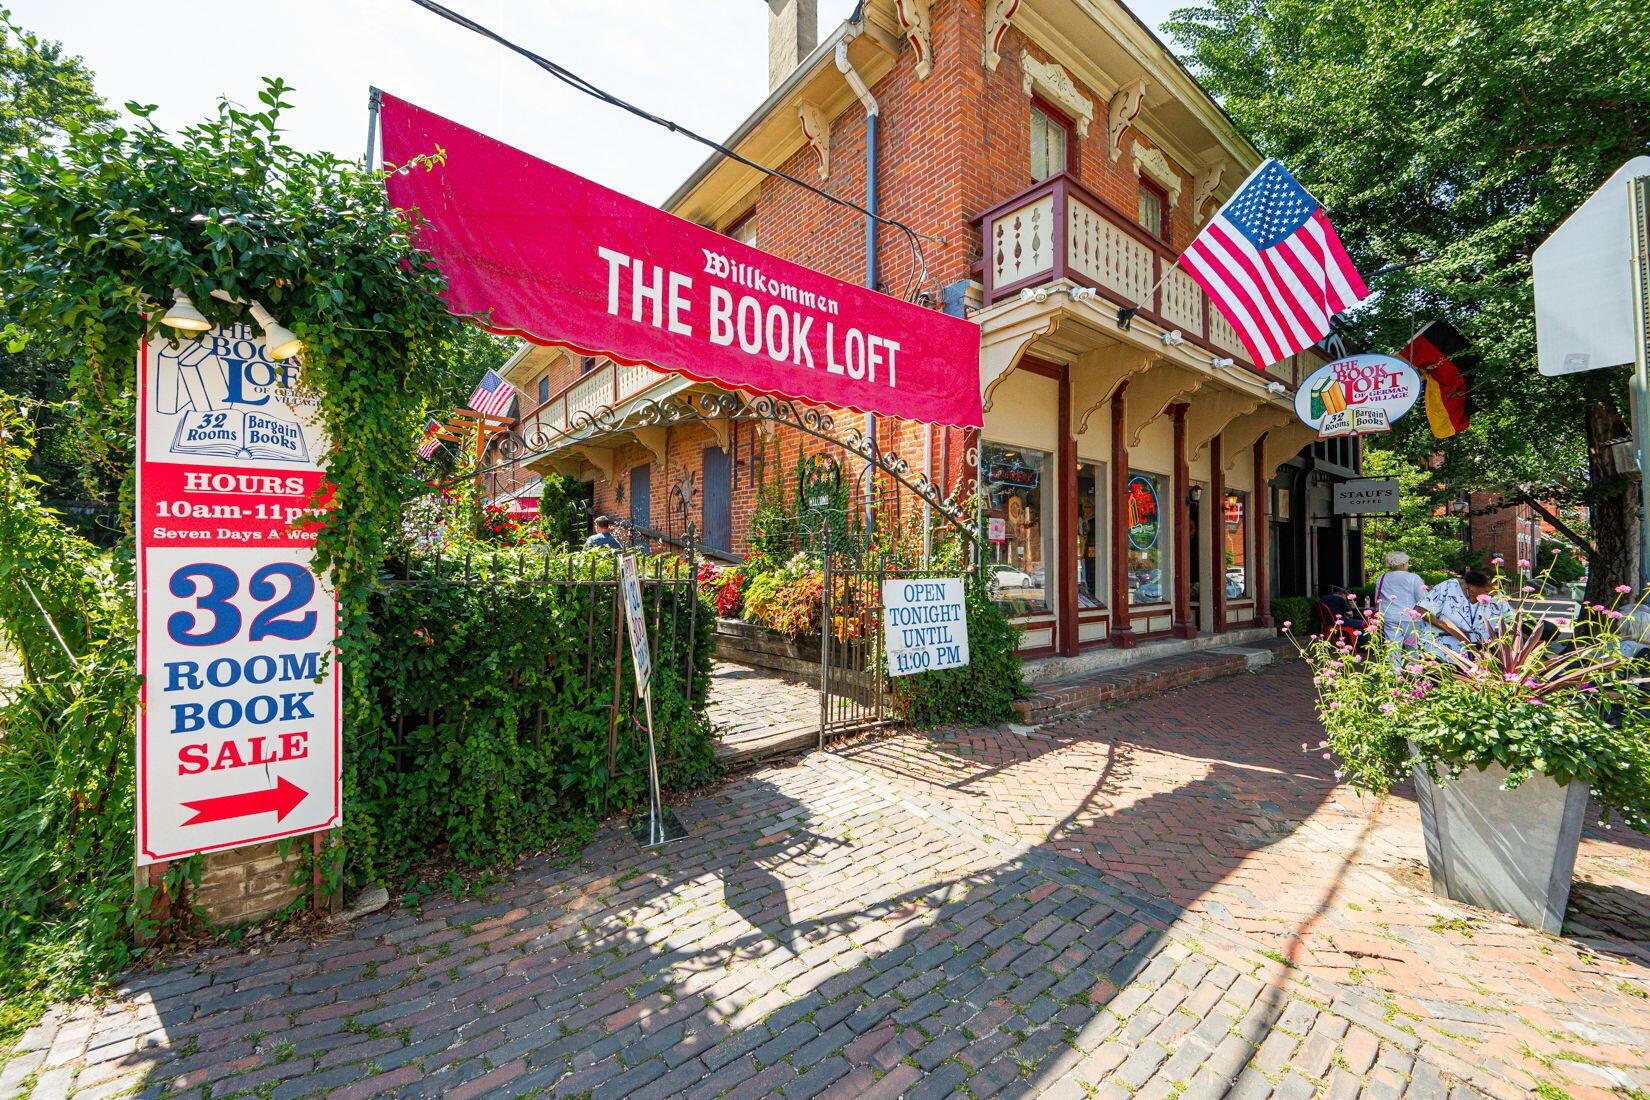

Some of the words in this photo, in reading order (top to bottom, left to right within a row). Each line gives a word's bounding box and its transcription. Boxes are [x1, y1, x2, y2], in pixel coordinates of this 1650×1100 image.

[701, 247, 839, 316] Willkommen
[598, 245, 694, 337] THE
[709, 285, 815, 369] BOOK
[826, 321, 901, 388] LOFT
[208, 321, 253, 341] HE
[1330, 360, 1359, 372] THE
[1336, 363, 1388, 382] BOOK
[220, 357, 300, 406] LOF
[254, 386, 270, 394] OF
[1341, 372, 1404, 404] LOFT
[1369, 386, 1409, 396] GERMAN
[1369, 392, 1409, 402] VILLAGE
[196, 412, 228, 429] 32
[1330, 412, 1345, 424] 32
[1355, 410, 1384, 419] Bargain
[1356, 418, 1384, 427] Books
[187, 428, 237, 441] Rooms
[248, 415, 297, 438] Bargain
[1324, 421, 1350, 431] Rooms
[249, 430, 297, 451] Books
[184, 472, 305, 496] HOURS
[153, 527, 212, 540] Seven
[216, 528, 262, 542] Days
[267, 529, 280, 540] A
[287, 529, 318, 541] Wee
[904, 584, 946, 603] OPEN
[167, 562, 318, 647] 32
[889, 604, 961, 627] TONIGHT
[902, 625, 953, 648] UNTIL
[897, 651, 930, 671] 11:00
[936, 645, 962, 665] PM
[163, 652, 321, 692] ROOM
[170, 691, 315, 734] BOOK
[177, 731, 309, 776] SALE
